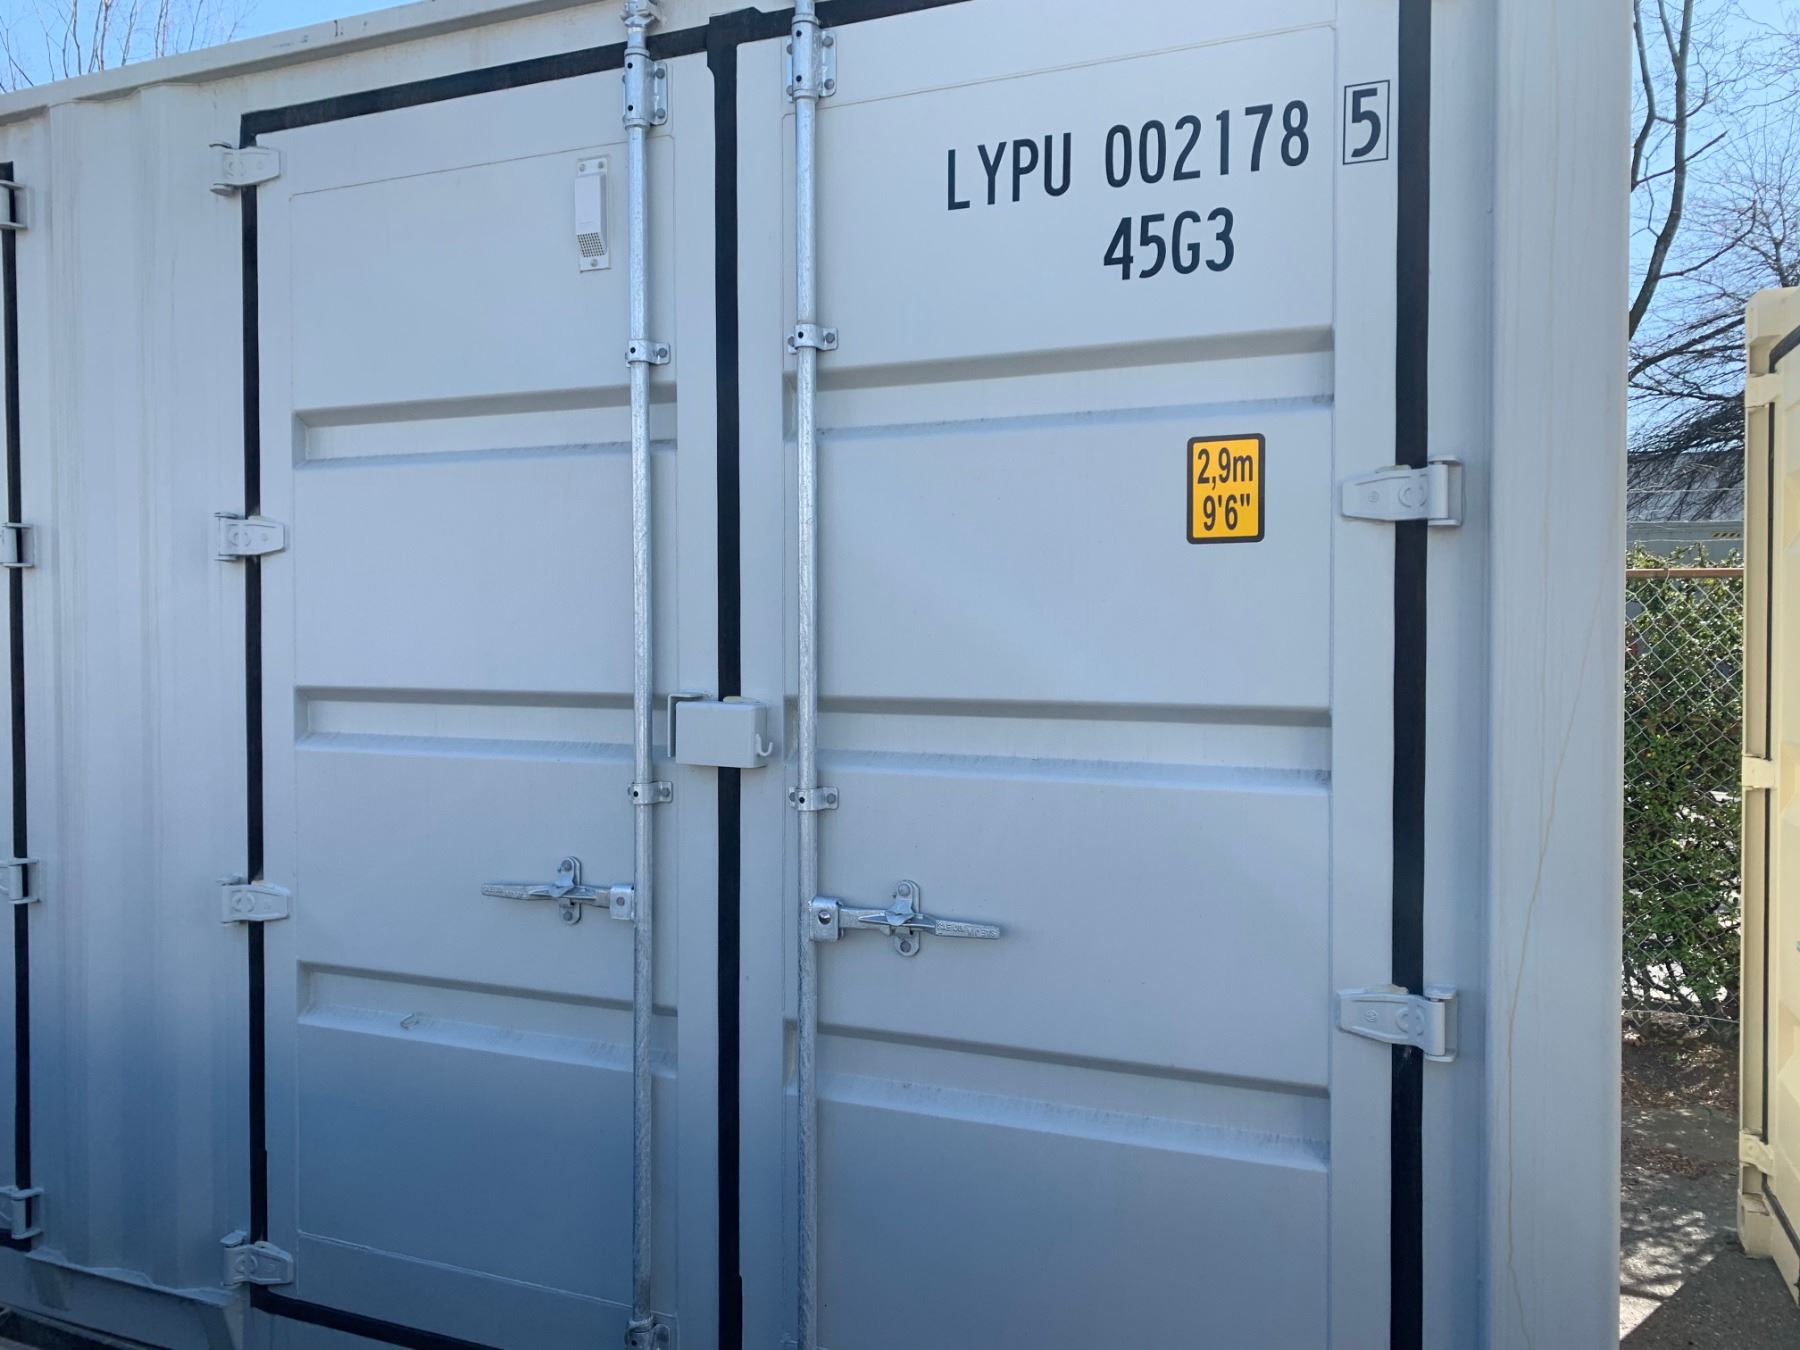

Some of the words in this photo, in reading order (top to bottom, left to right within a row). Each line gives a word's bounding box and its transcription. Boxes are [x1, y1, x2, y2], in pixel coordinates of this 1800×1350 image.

[947, 132, 1072, 211] LYPU
[1105, 100, 1309, 188] 002178
[1351, 87, 1381, 158] 5
[1103, 207, 1235, 281] 45G3
[1197, 447, 1254, 490] 2,9m
[1203, 493, 1251, 531] 9'6"
